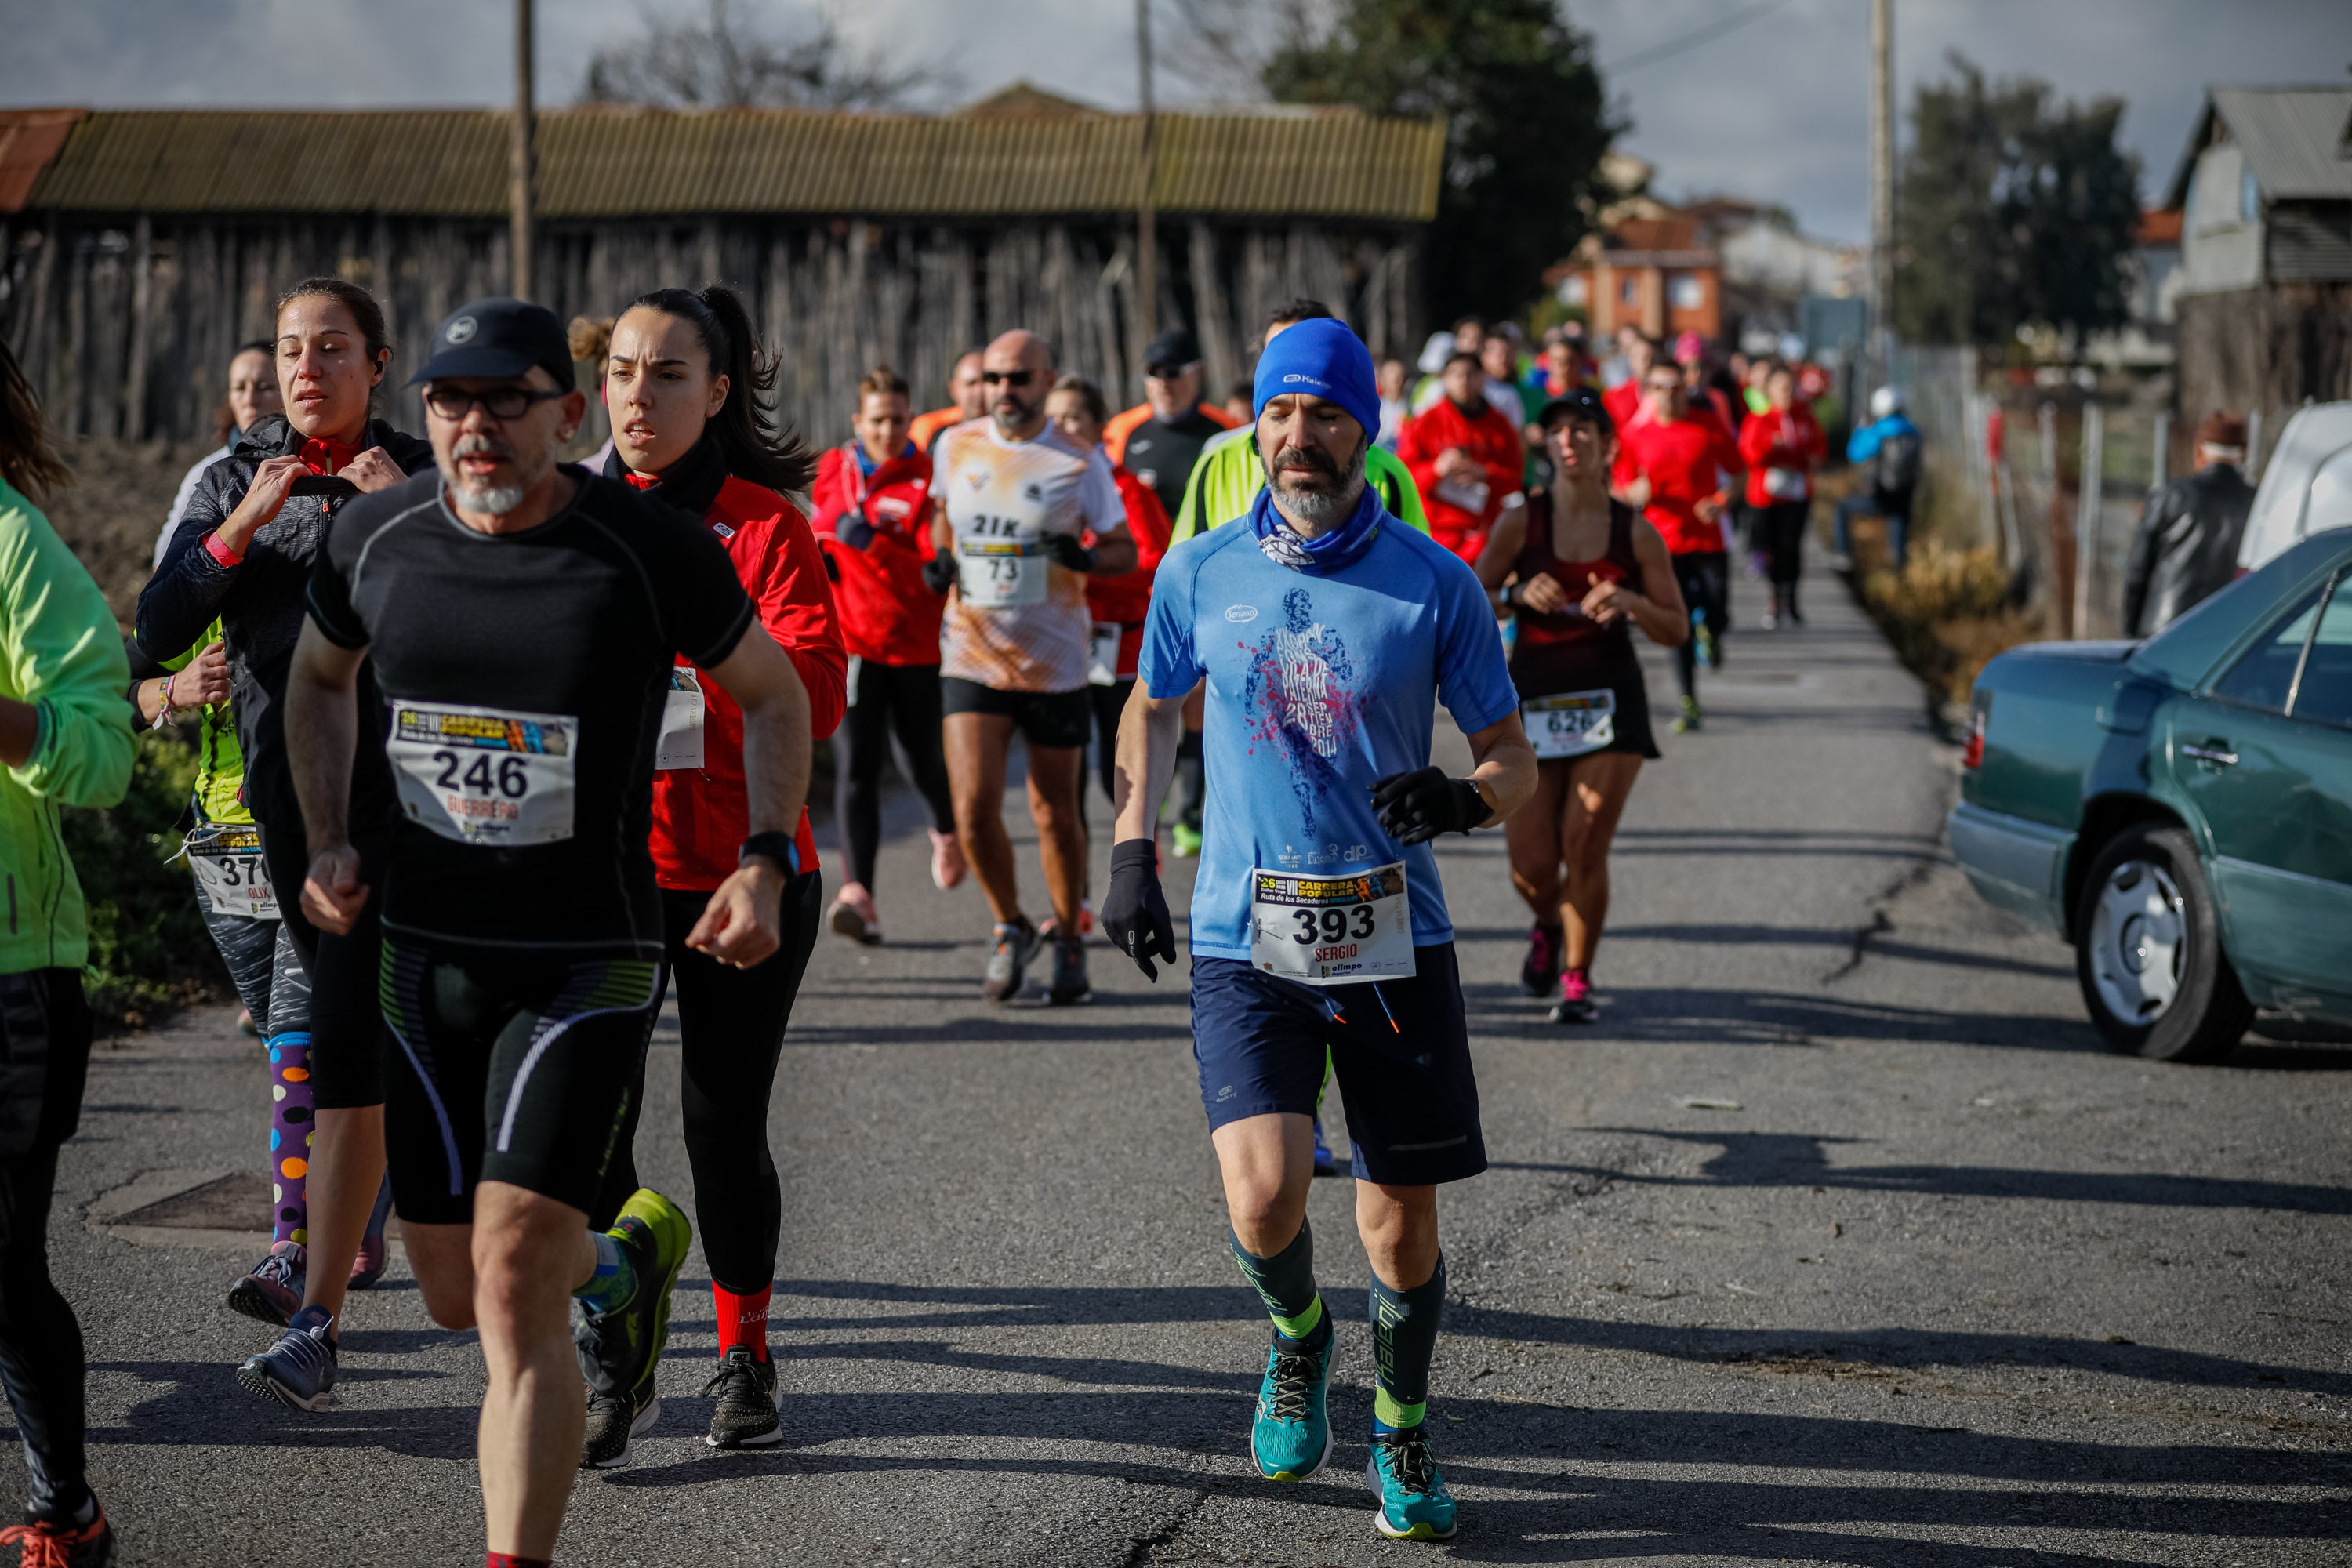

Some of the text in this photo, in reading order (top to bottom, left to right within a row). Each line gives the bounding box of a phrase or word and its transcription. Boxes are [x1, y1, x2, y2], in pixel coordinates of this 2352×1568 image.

[973, 514, 1019, 537] 21K
[988, 558, 1018, 580] 73
[1282, 673, 1328, 703] PATERNA
[1283, 702, 1327, 731] 28 SEP
[1308, 713, 1333, 725] TIEM
[1548, 710, 1593, 734] 626
[1310, 724, 1333, 738] BRE
[1311, 736, 1338, 758] 2014
[434, 750, 528, 798] 246
[447, 794, 519, 820] GUERRERO
[1260, 877, 1276, 889] 26
[1286, 879, 1355, 896] VII CARRERA
[1298, 889, 1355, 898] POPULAR
[1292, 904, 1375, 945] 393
[1315, 943, 1358, 963] SERGIO
[1331, 963, 1363, 972] olimpo
[1372, 1288, 1406, 1386] Kalenji
